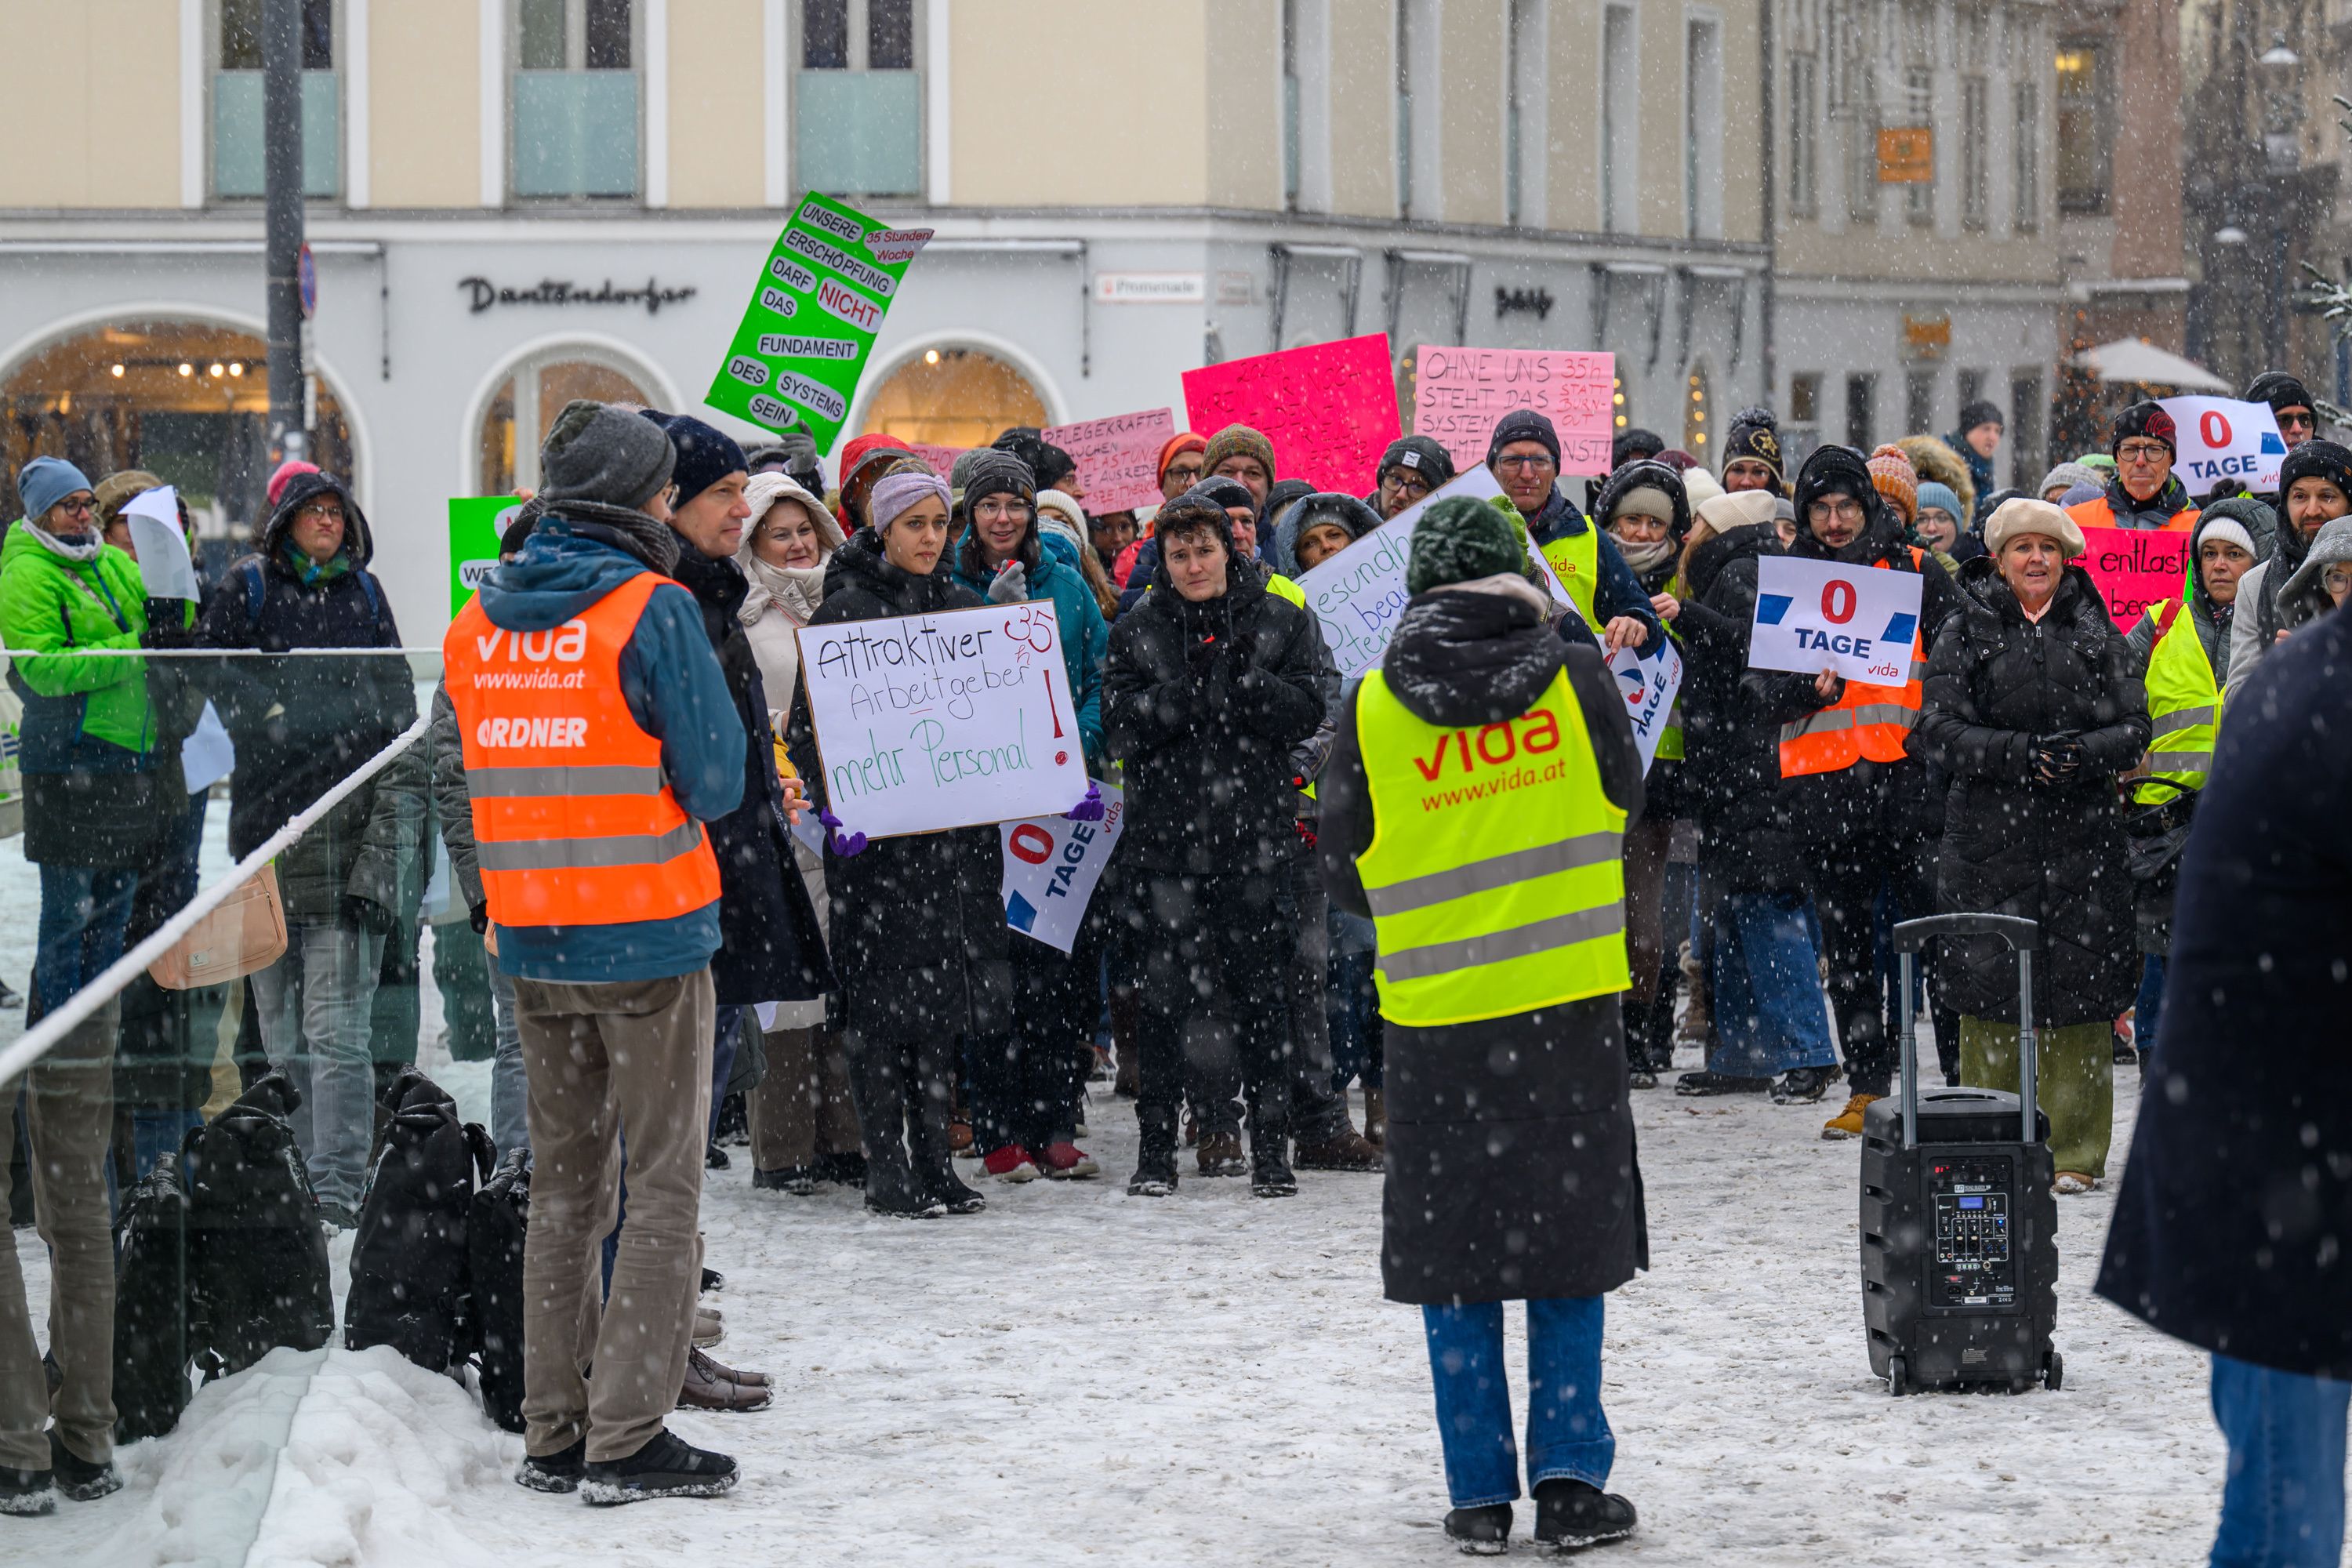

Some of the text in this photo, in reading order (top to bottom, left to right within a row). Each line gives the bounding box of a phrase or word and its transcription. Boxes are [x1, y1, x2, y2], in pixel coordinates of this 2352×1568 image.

[802, 203, 860, 241] UNSERE
[866, 231, 881, 244] 35
[786, 230, 890, 293] ERSCHÖPFUNG
[877, 248, 914, 261] Woche
[764, 290, 794, 316] DAS
[773, 259, 880, 327] DARF NICHT
[760, 336, 855, 358] FUNDAMENT
[1425, 352, 1552, 383] OHNE UNS
[730, 359, 844, 419] DES SYSTEMS
[1422, 387, 1549, 410] STEHT DAS
[1559, 384, 1608, 397] STATT
[751, 397, 793, 424] SEIN
[1421, 414, 1494, 433] SYSTEM
[2199, 410, 2233, 449] 0
[2189, 454, 2258, 479] TAGE
[2260, 471, 2280, 484] vid
[1820, 579, 1857, 625] 0
[817, 616, 993, 679] Attraktiver
[1004, 606, 1054, 653] 35
[1795, 628, 1872, 659] TAGE
[474, 667, 586, 689] www.vida.at
[1867, 662, 1899, 677] vida
[851, 659, 1030, 720] Arbeitgeber
[1636, 671, 1668, 738] TAGE
[477, 717, 588, 748] ORDNER
[832, 708, 1033, 803] mehr Personal
[1421, 758, 1566, 812] www.vida.at
[1104, 801, 1123, 834] vida
[1009, 823, 1054, 865] 0
[1045, 822, 1096, 898] TAGE
